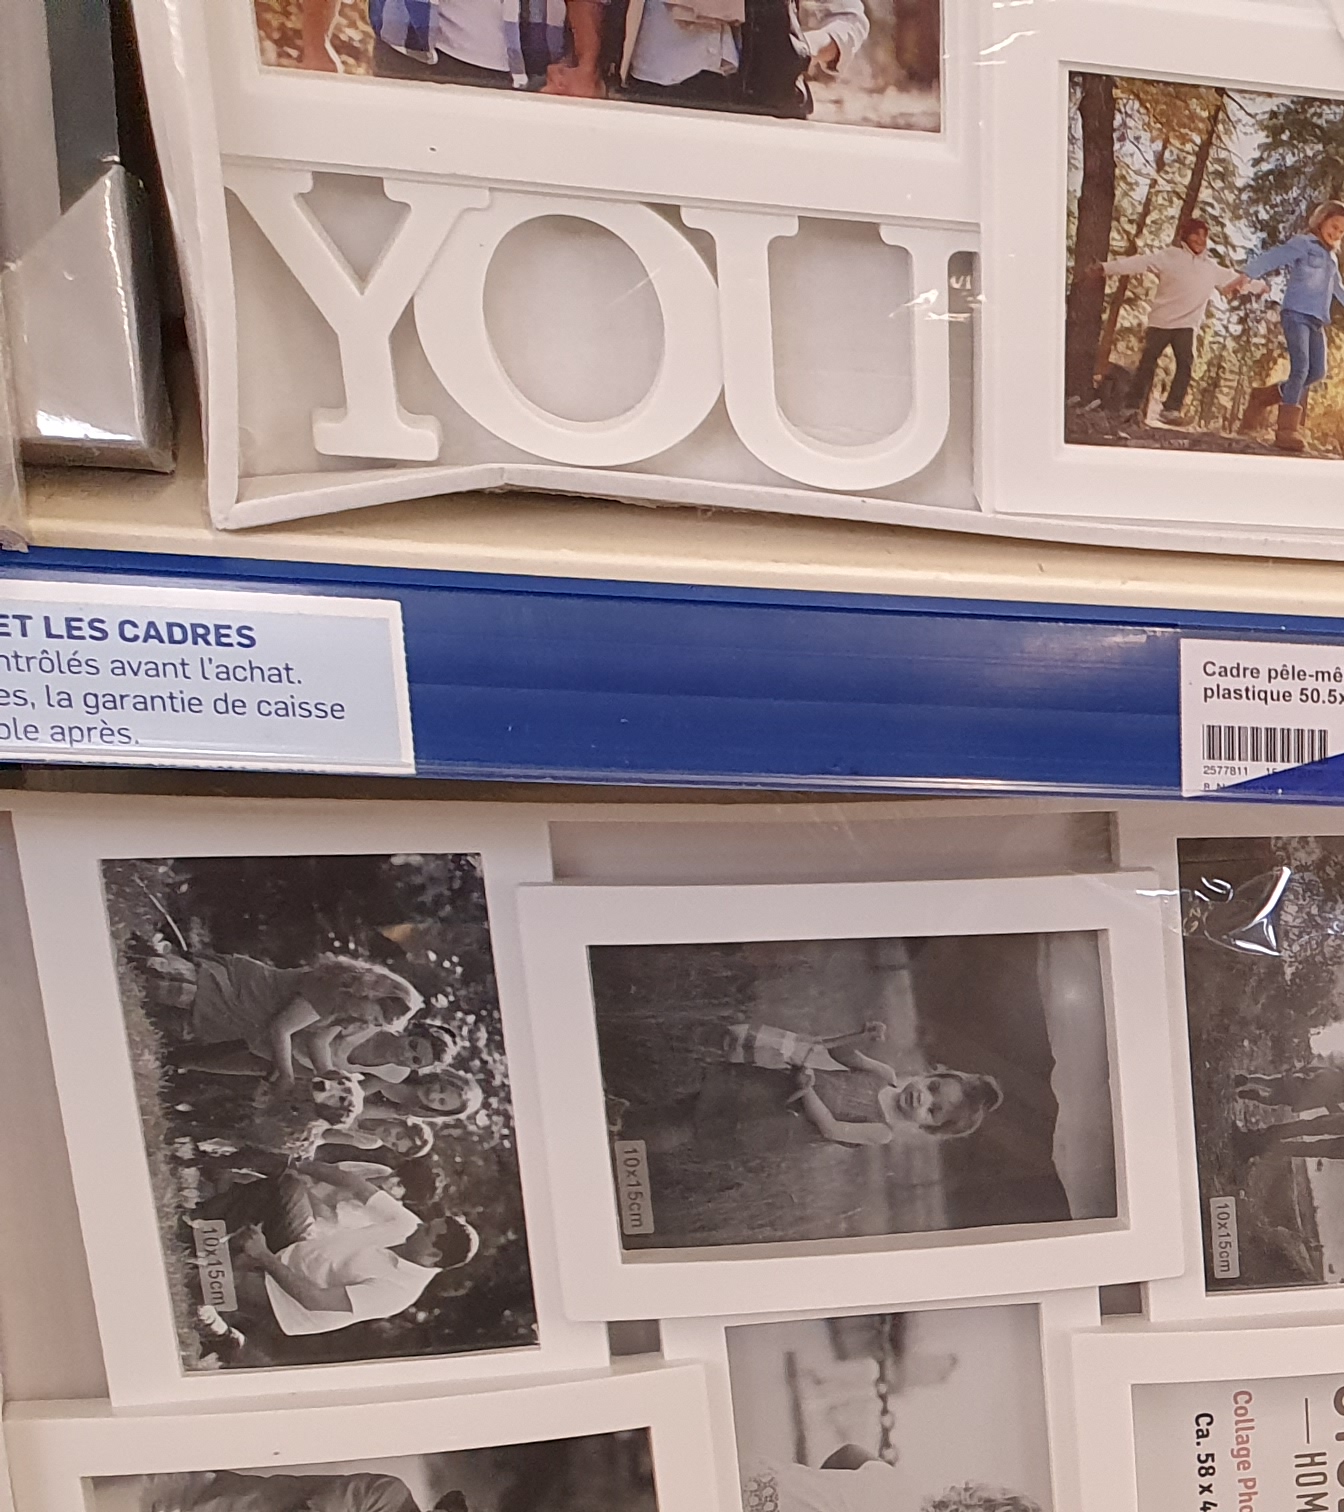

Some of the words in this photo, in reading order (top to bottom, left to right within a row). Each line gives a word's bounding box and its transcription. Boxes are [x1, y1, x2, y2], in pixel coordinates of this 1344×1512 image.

[223, 170, 981, 491] YOU
[44, 616, 109, 642] LES
[118, 619, 257, 649] CADRES
[110, 657, 191, 680] avant
[200, 658, 303, 684] l'achat.
[1202, 660, 1261, 680] Cadre
[45, 685, 73, 708] la
[83, 690, 203, 715] garantie
[213, 693, 247, 716] de
[257, 696, 346, 720] caisse
[1203, 684, 1293, 705] plastique
[50, 720, 140, 748] après.
[1203, 765, 1249, 776] 2577811
[622, 1147, 642, 1228] 10x15cm
[1218, 1202, 1231, 1274] 10x15cm
[201, 1226, 227, 1307] 10x15cm
[1194, 1411, 1215, 1447] Ca.
[1231, 1389, 1255, 1472] Collage
[1196, 1453, 1216, 1477] 58
[1199, 1483, 1214, 1495] x
